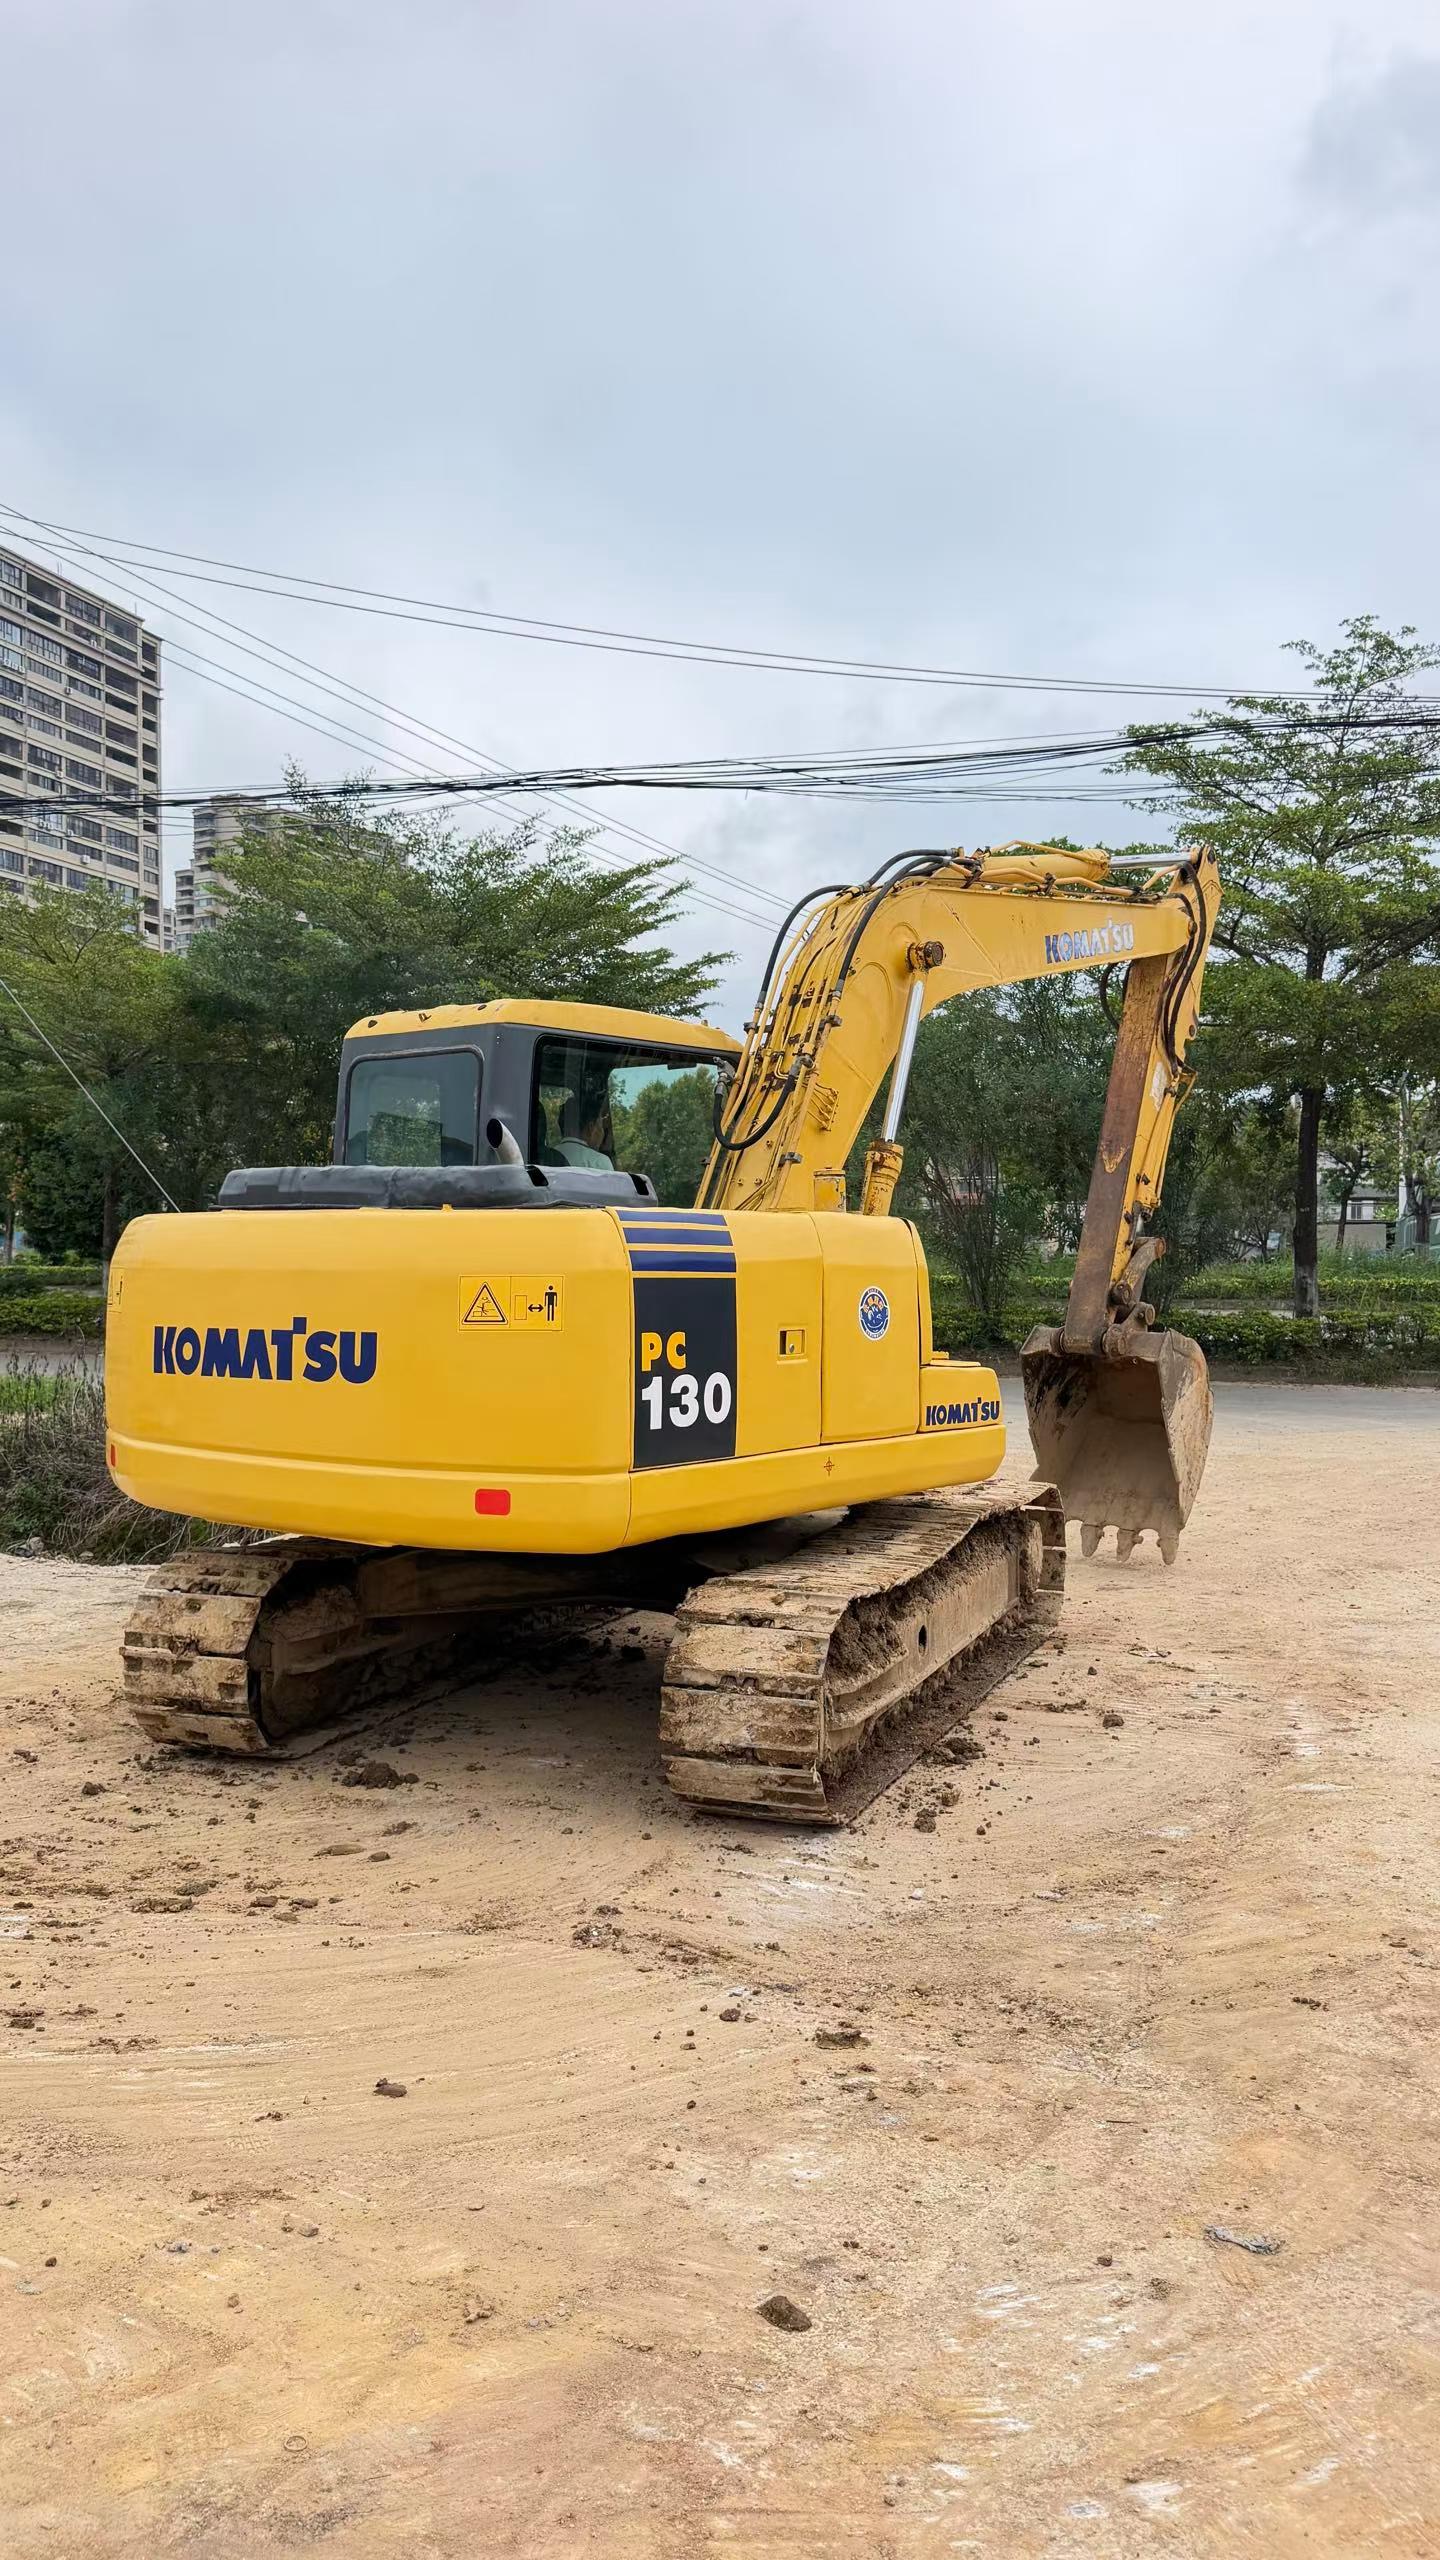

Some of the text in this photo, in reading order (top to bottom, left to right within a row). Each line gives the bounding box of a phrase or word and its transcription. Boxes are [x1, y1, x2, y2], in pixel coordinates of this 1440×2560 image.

[1045, 918, 1134, 964] KOMATSU
[153, 1316, 378, 1384] KOMATSU
[641, 1331, 687, 1372] PC
[641, 1371, 732, 1430] 130
[925, 1396, 1000, 1426] KOMATSU
